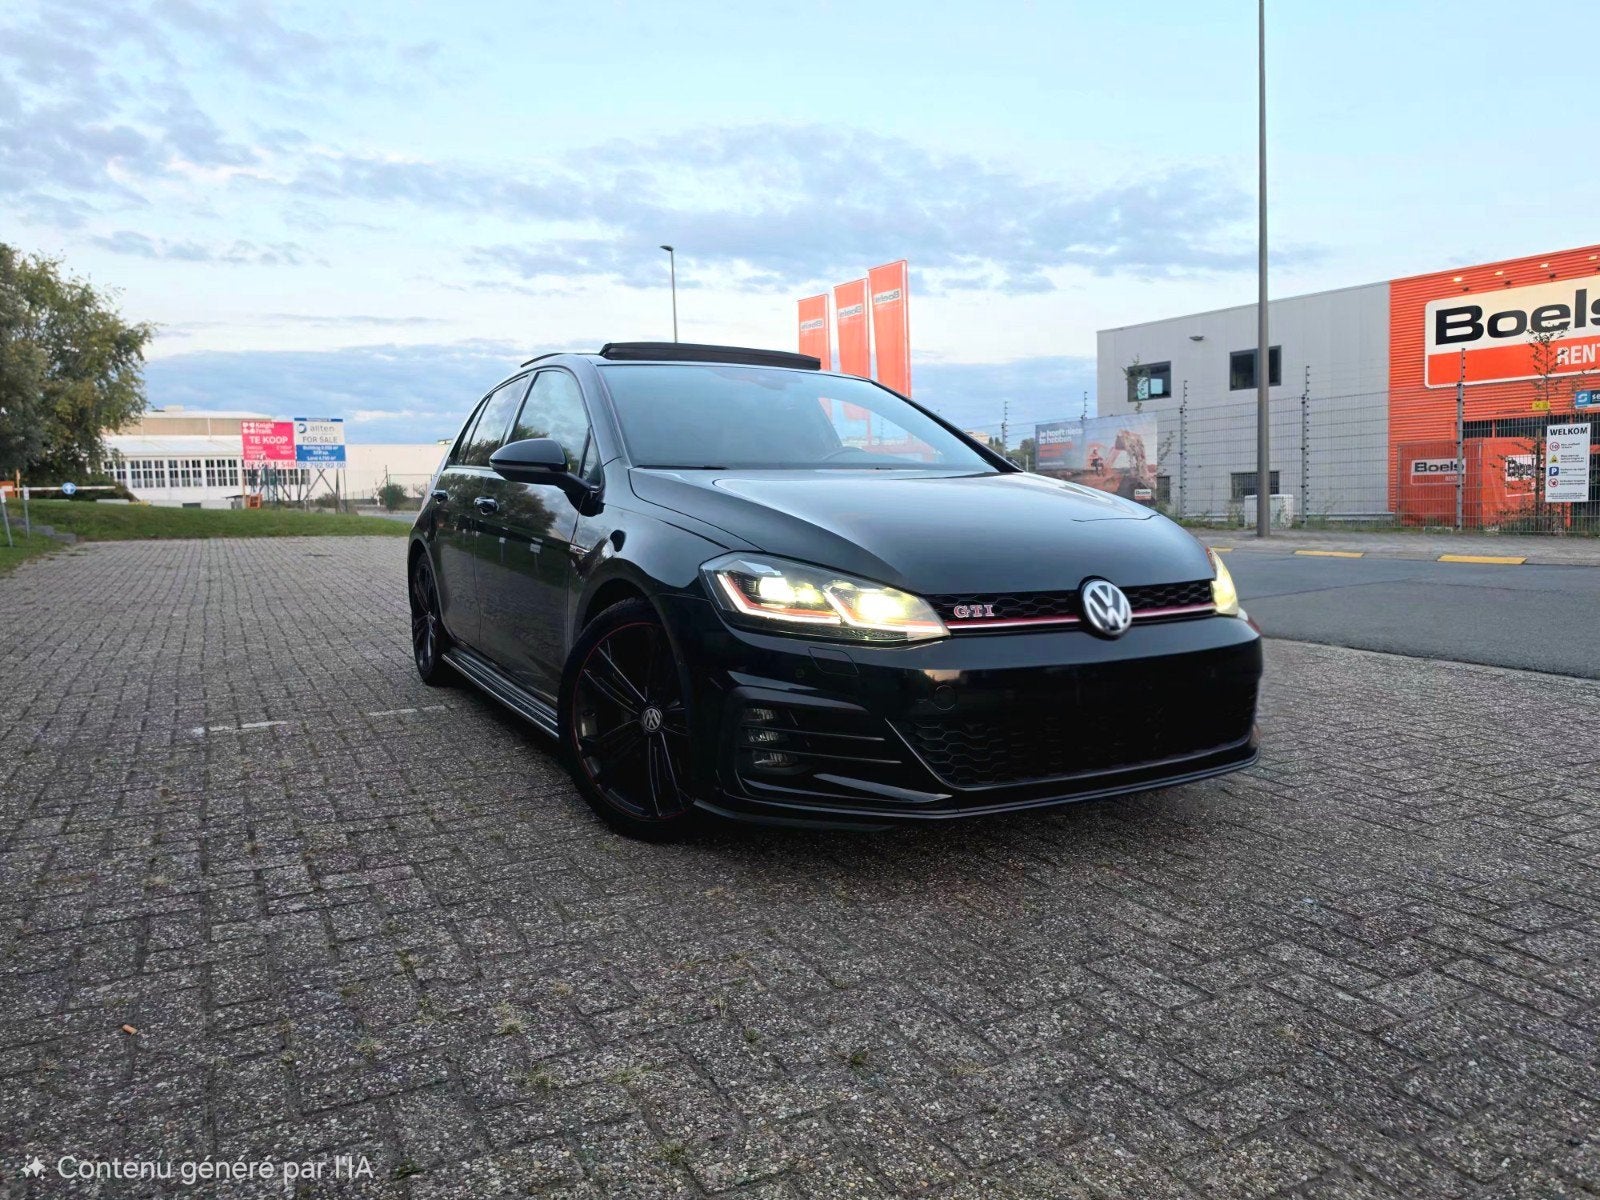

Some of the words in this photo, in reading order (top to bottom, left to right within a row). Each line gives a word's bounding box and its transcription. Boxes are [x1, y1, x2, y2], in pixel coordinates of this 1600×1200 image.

[1436, 289, 1600, 346] Boel
[1557, 344, 1600, 365] REN
[1550, 427, 1587, 436] WELKOM
[249, 436, 261, 444] TE
[263, 436, 288, 444] KOOP
[953, 605, 994, 618] GTI
